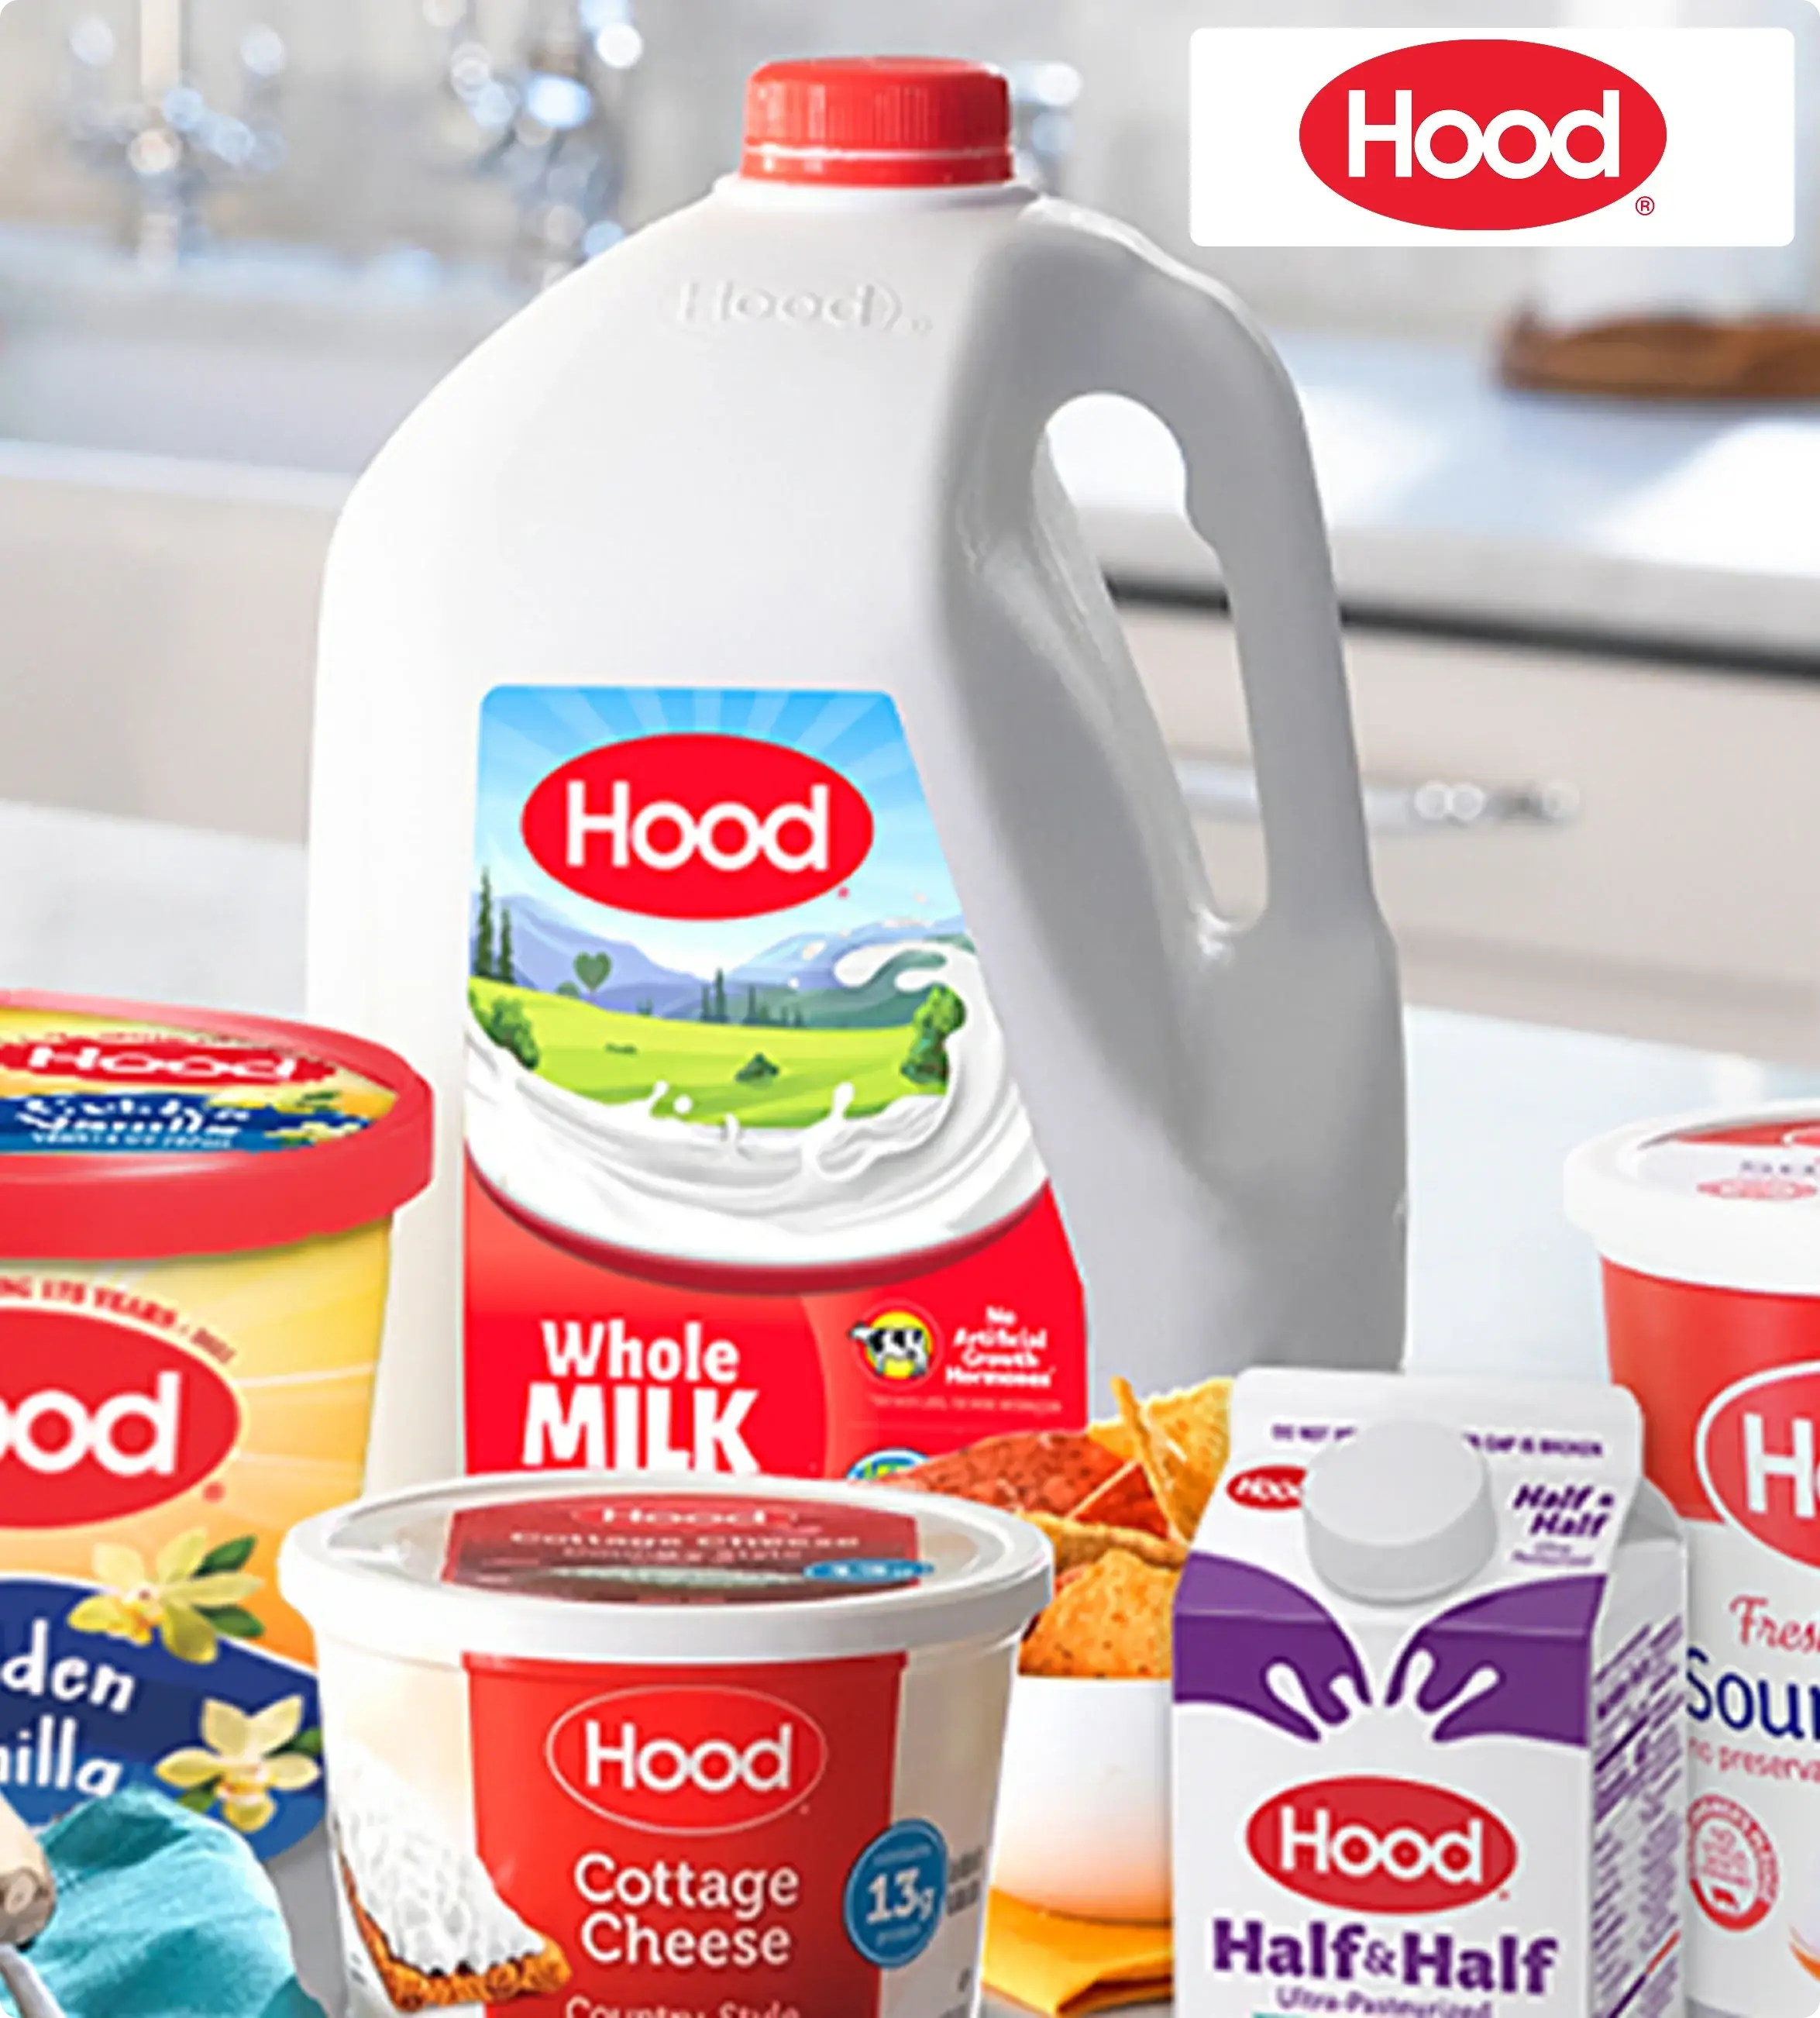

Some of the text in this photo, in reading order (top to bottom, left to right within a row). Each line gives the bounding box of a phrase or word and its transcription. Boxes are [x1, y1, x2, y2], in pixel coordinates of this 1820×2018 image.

[566, 780, 830, 873] Hood
[28, 1046, 297, 1080] Hood
[952, 1327, 1048, 1350] Artificial
[986, 1306, 1017, 1326] No
[541, 1319, 740, 1383] Whole
[961, 1345, 1040, 1368] Growth
[0, 1369, 181, 1477] od
[521, 1383, 760, 1474] MILK
[1743, 1412, 1820, 1519] H
[1234, 1475, 1304, 1502] Hoo
[1513, 1483, 1593, 1510] Half
[603, 1507, 766, 1524] Hood
[1528, 1512, 1610, 1538] Half
[510, 1531, 860, 1549] Cottage Cheese
[585, 1719, 793, 1792] Hood
[1279, 1805, 1483, 1885] Hood
[574, 1851, 799, 1922] Cottage
[582, 1911, 791, 1967] Cheese
